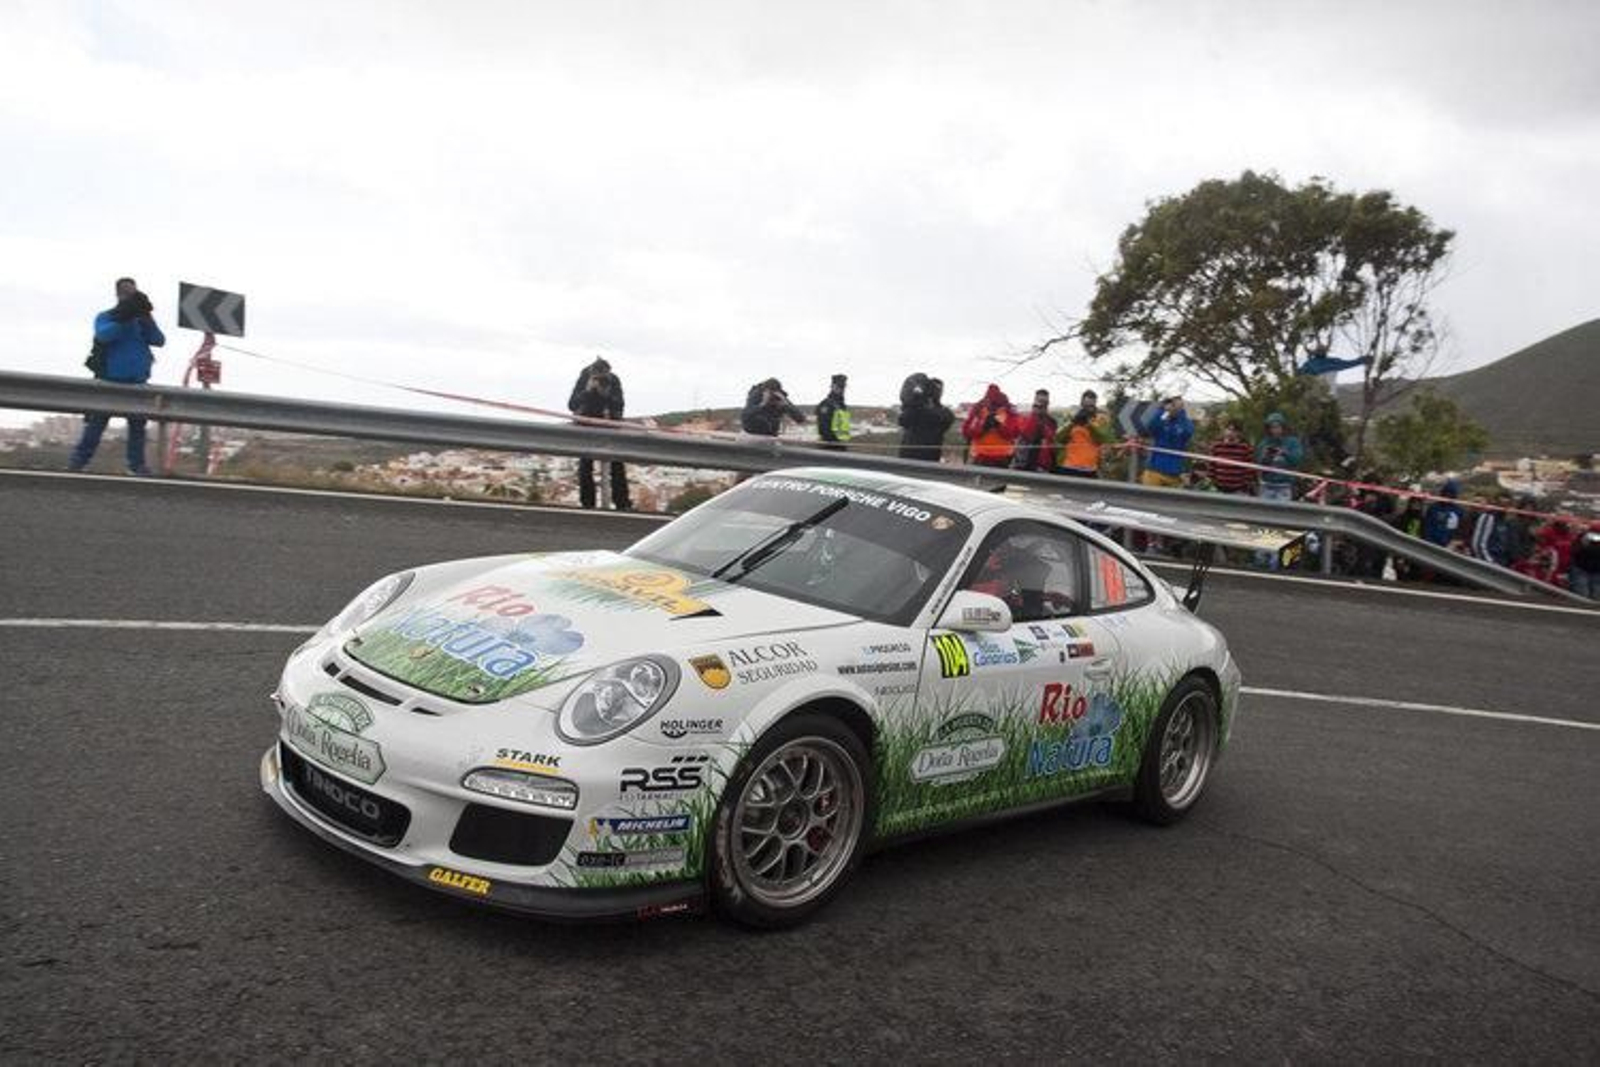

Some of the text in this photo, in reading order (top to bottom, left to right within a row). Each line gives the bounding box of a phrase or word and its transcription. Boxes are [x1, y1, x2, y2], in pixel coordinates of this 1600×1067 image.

[809, 486, 888, 508] PORSCHE
[886, 499, 932, 522] VIGO
[728, 641, 808, 667] ALCOR
[737, 659, 819, 685] SEGURIDAD
[1039, 682, 1088, 724] Rio
[660, 719, 724, 730] HOLINGER
[496, 748, 562, 768] STARK
[1025, 736, 1114, 777] Natura
[620, 766, 702, 793] RSS
[617, 818, 688, 831] MICHELIN
[428, 867, 492, 895] GALFER
